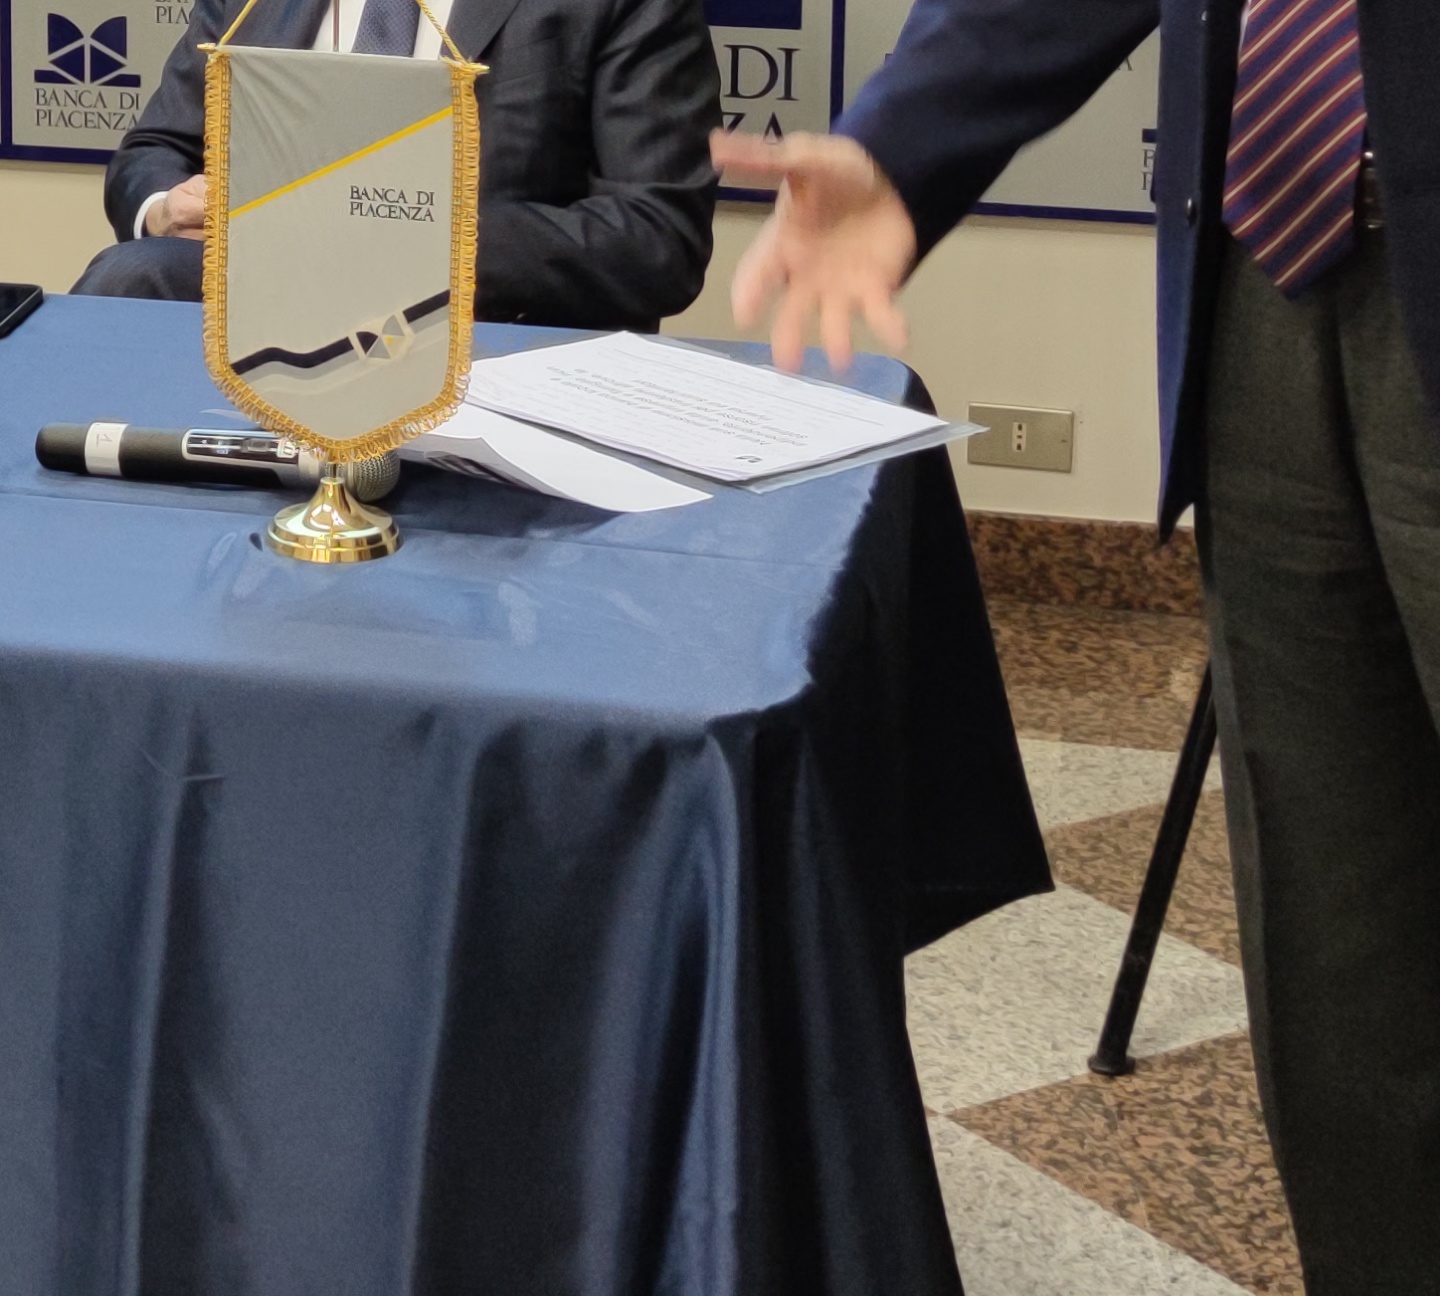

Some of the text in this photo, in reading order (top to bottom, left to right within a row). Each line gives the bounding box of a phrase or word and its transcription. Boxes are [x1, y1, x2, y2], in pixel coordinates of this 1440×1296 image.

[723, 45, 800, 101] DI
[35, 88, 139, 110] BANCA DI
[349, 185, 435, 207] BANCA DI
[349, 201, 435, 223] PIACENZA
